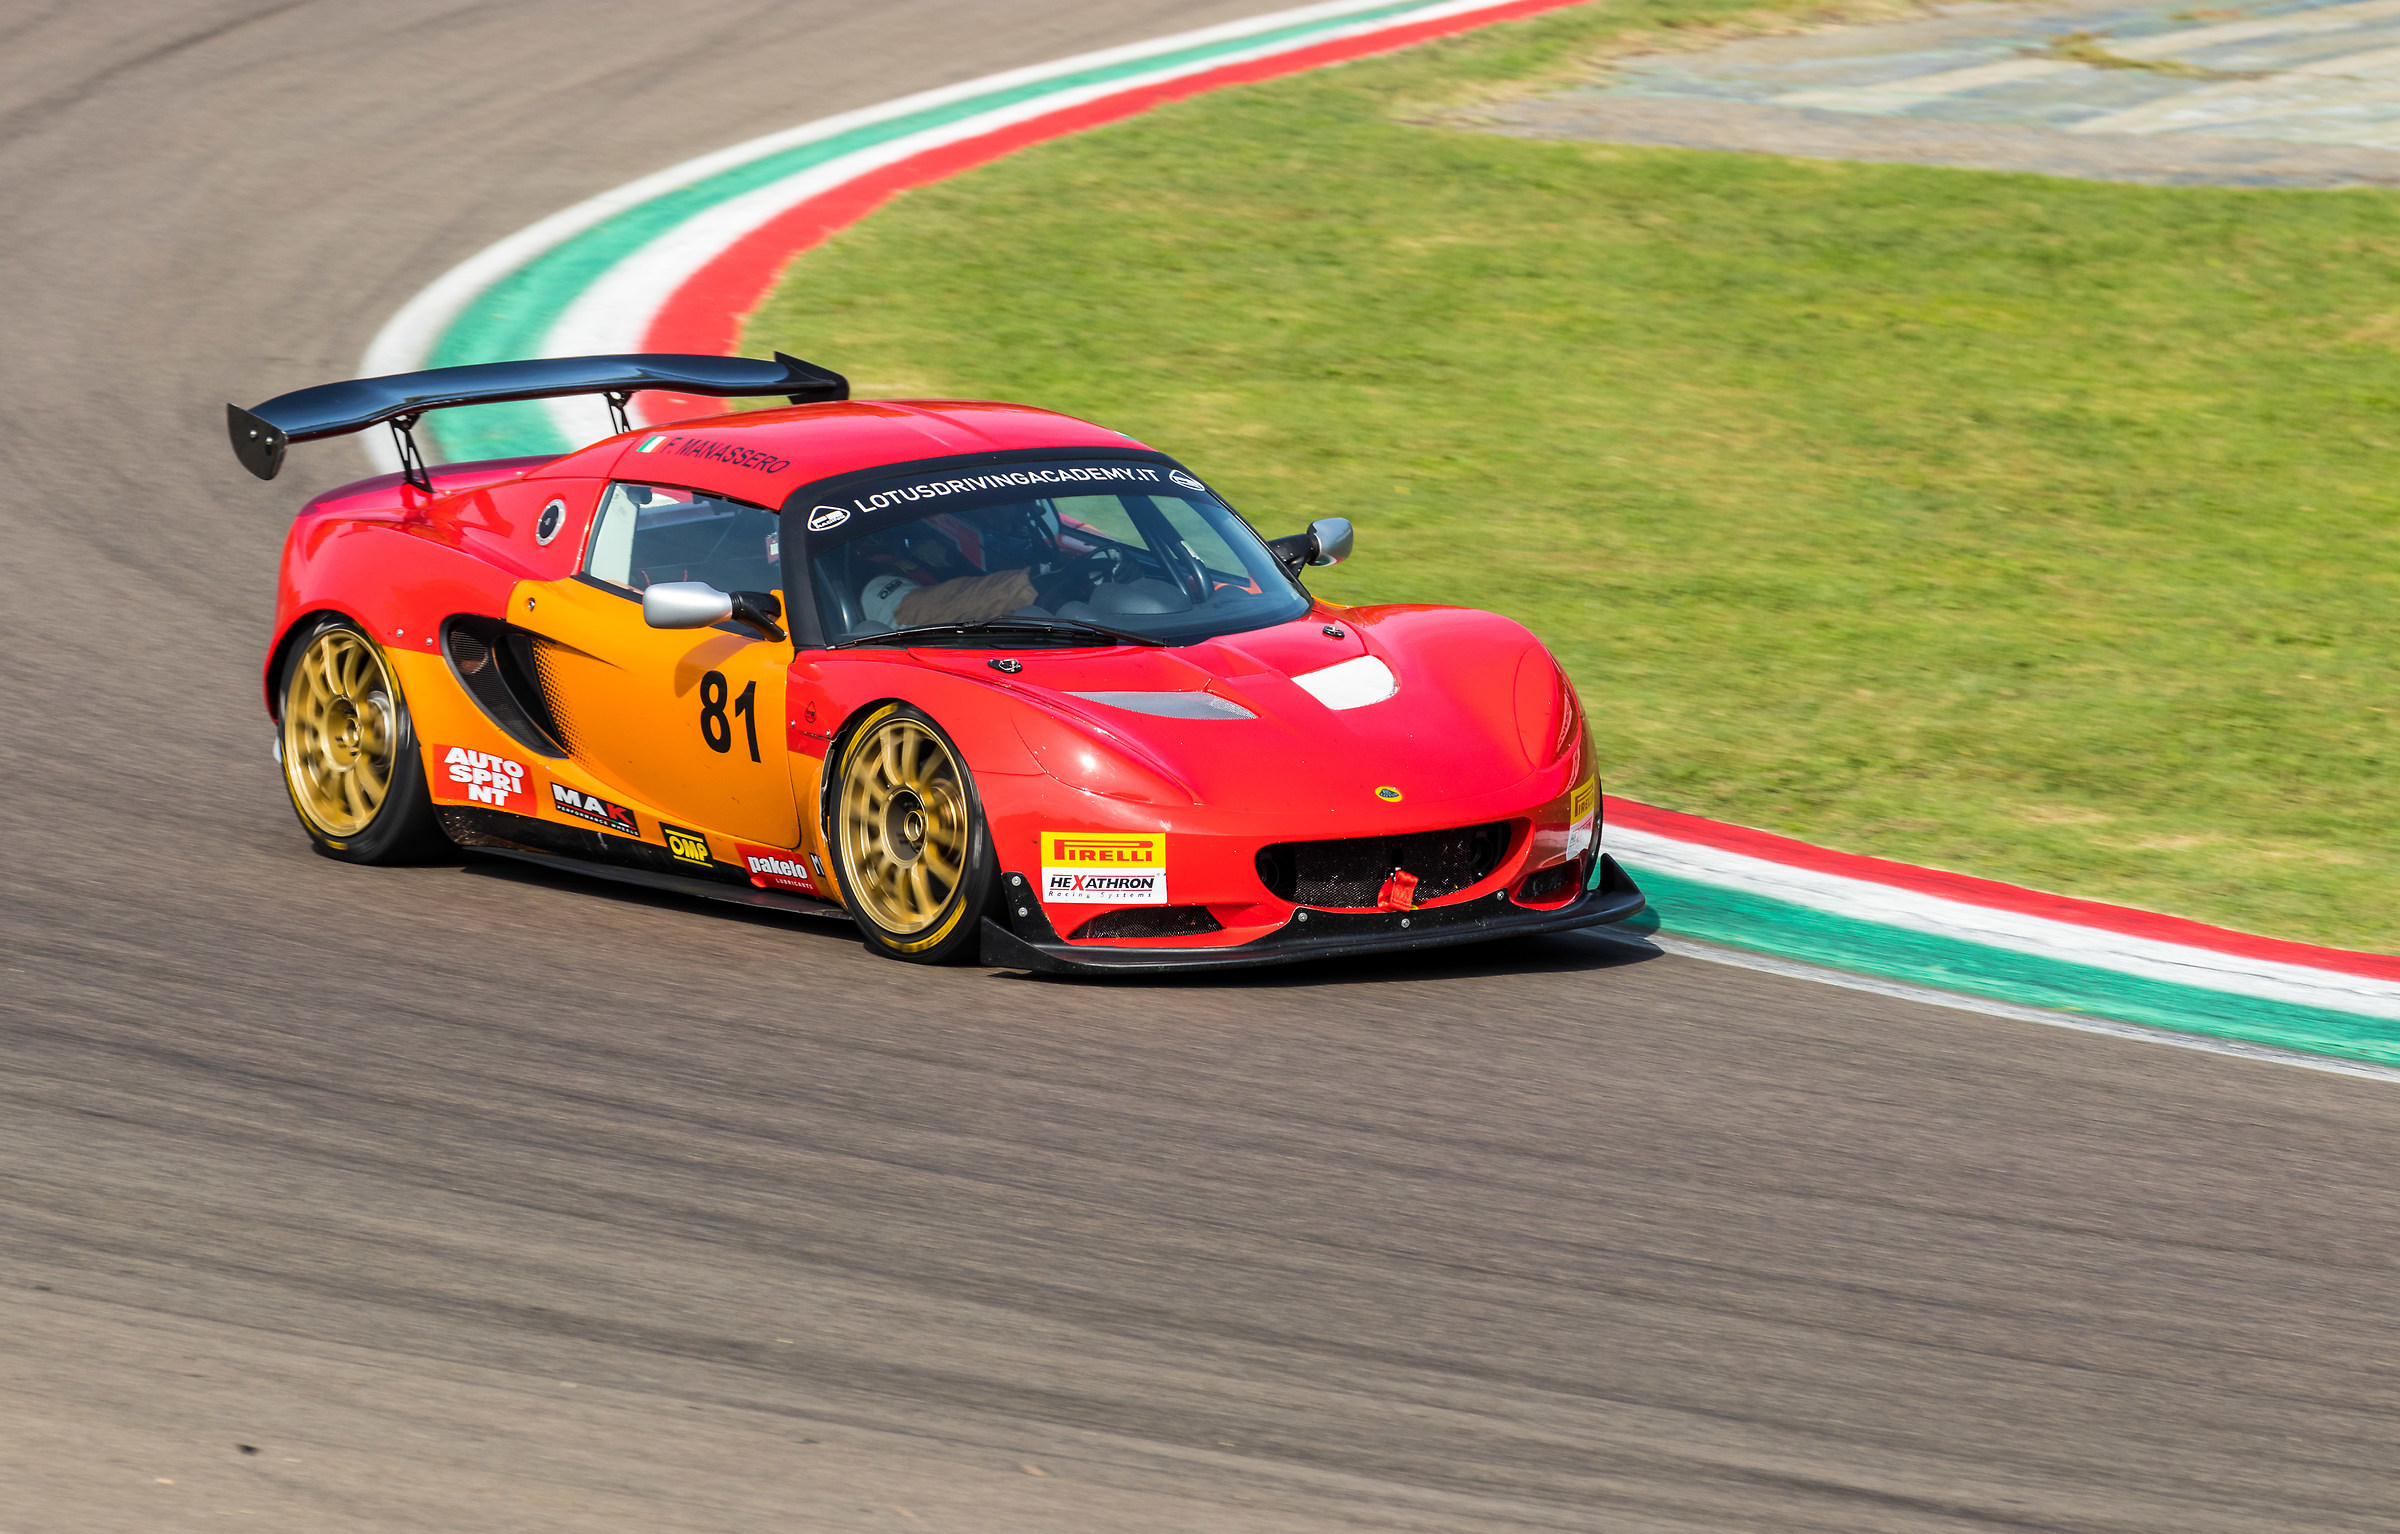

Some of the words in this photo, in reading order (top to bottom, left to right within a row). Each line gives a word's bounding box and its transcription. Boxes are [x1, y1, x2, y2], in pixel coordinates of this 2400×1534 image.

[676, 438, 791, 474] MANASSERO
[853, 467, 1160, 514] LOTUSDRIVINGACADEMY.IT
[700, 669, 762, 764] 81
[444, 746, 525, 778] AUTO
[448, 763, 522, 794] SPRI
[468, 783, 509, 807] NT
[552, 783, 635, 826] MAK
[557, 804, 609, 826] PERFORMANCE
[610, 823, 640, 836] WHEELS
[668, 835, 709, 862] OMP
[1053, 839, 1154, 862] PIRELLI
[747, 856, 808, 880] pakelo
[1050, 874, 1155, 891] HEXATHRON
[1048, 891, 1091, 899] Racing
[1100, 891, 1152, 899] Systems
